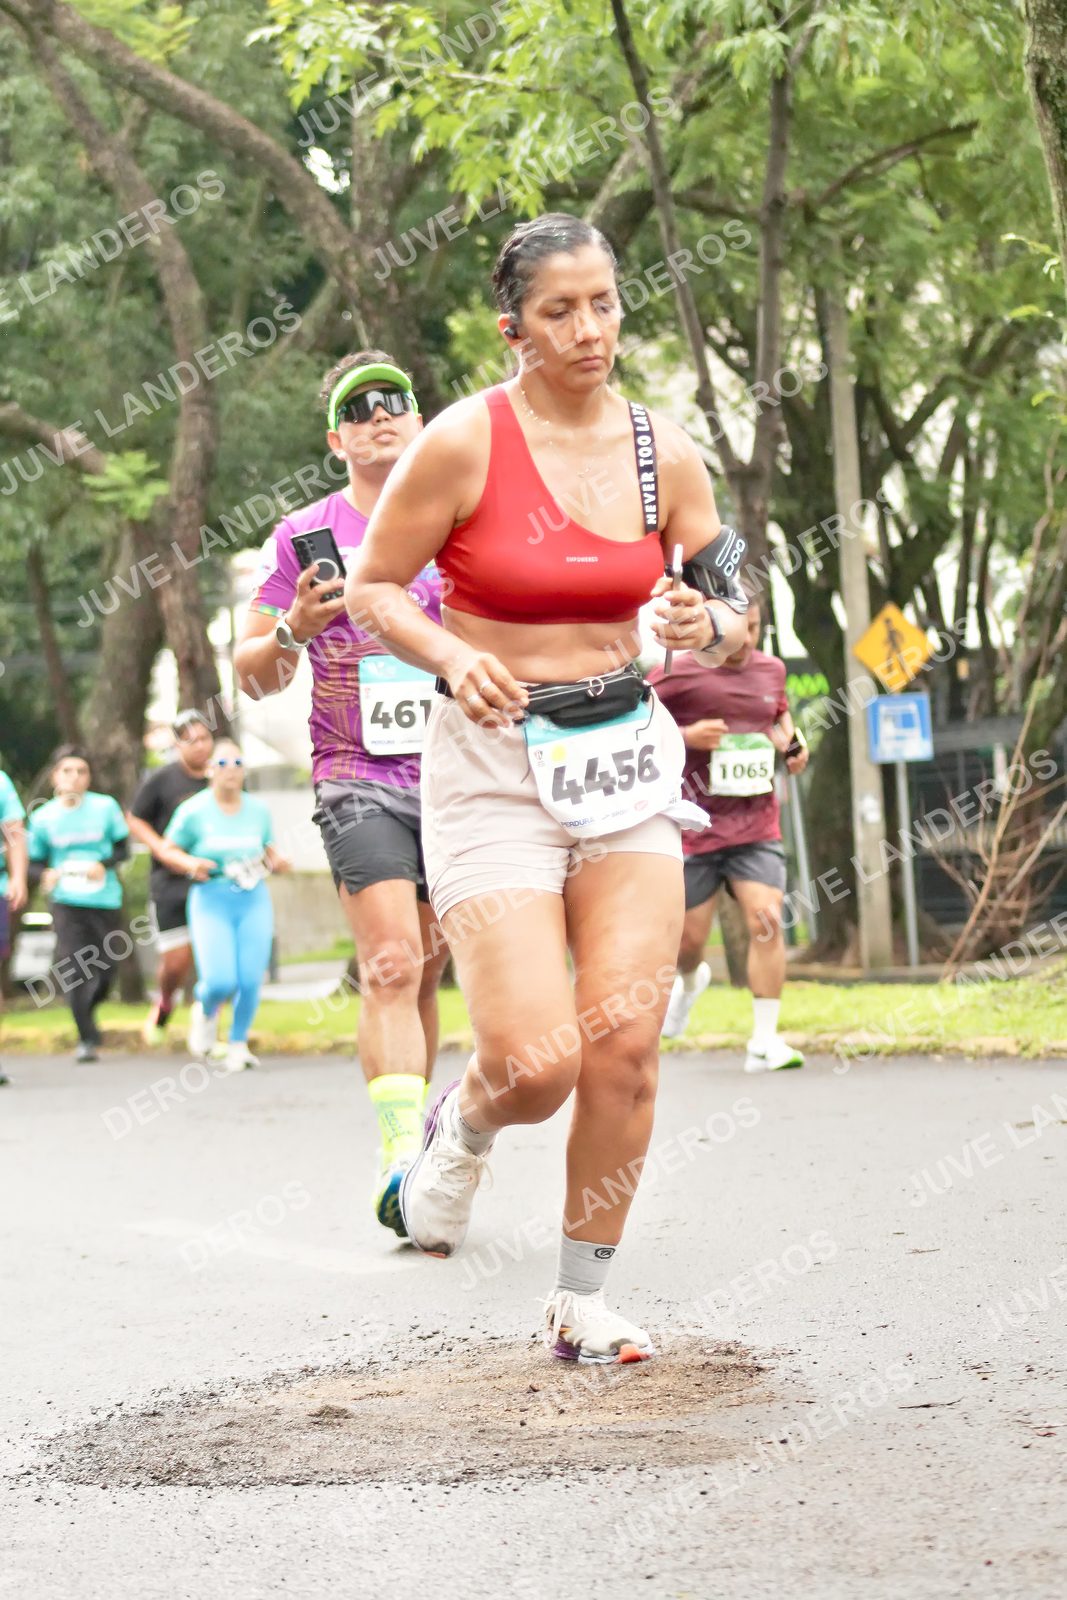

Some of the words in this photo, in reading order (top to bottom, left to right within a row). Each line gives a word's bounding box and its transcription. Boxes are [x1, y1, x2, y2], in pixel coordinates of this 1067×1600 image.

[636, 435, 654, 467] TOO
[641, 471, 657, 525] NEVER
[551, 744, 661, 806] 4456
[720, 763, 768, 779] 1065
